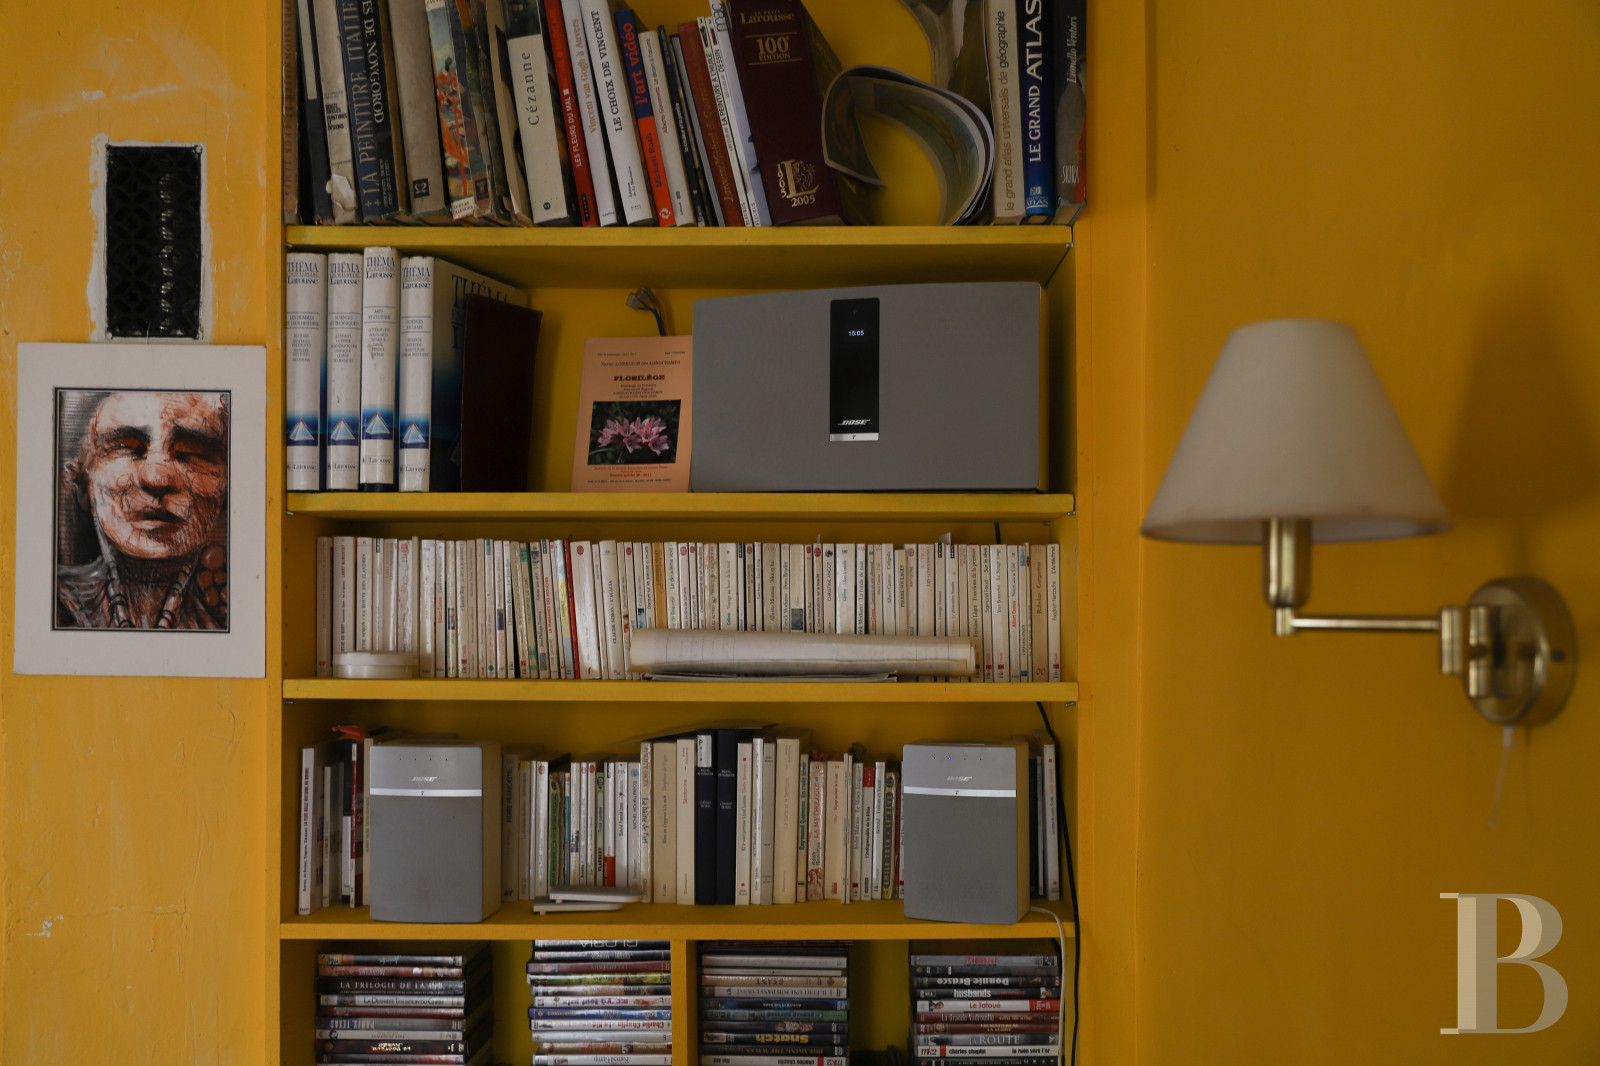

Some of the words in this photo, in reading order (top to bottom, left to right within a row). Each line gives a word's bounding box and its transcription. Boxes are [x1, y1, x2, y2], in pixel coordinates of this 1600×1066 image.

[740, 12, 796, 25] Larousse
[342, 0, 364, 62] ITALIE
[362, 17, 375, 38] DE
[590, 8, 608, 59] VINCENT
[1066, 15, 1077, 46] Venturi
[618, 21, 640, 68] vidéo
[994, 10, 1008, 70] géographie
[1024, 0, 1042, 81] ATLAS
[600, 60, 612, 76] DE
[713, 48, 724, 73] DESSIN
[1065, 46, 1078, 83] Lionello
[577, 58, 590, 81] Gogh
[364, 40, 386, 123] NOVGOROD
[997, 70, 1008, 86] de
[518, 51, 540, 126] Cézanne
[582, 81, 592, 98] van
[629, 69, 648, 105] l'art
[563, 95, 572, 112] MAL
[604, 78, 619, 115] CHOIX
[712, 83, 725, 117] PEINTURE
[356, 70, 376, 164] PEINTURE
[566, 112, 574, 124] DU
[584, 100, 598, 134] Vincent
[998, 87, 1010, 139] universalis
[1027, 84, 1041, 140] GRAND
[612, 116, 623, 132] LE
[720, 116, 728, 126] LA
[568, 124, 579, 152] FLEURS
[573, 152, 582, 167] LES
[1001, 141, 1012, 166] atlas
[1029, 142, 1041, 162] LE
[362, 170, 380, 196] LA
[1003, 167, 1015, 199] grand
[790, 194, 816, 208] 2005
[1004, 201, 1014, 211] le
[286, 260, 318, 273] THÉMA
[330, 260, 360, 274] THÉMA
[366, 254, 396, 268] THÉMA
[366, 271, 396, 280] Larousse
[402, 265, 430, 278] THÉMA
[288, 276, 319, 286] Larousse
[330, 277, 360, 286] Larousse
[402, 281, 430, 290] Larousse
[614, 373, 666, 382] FLORILÈGE
[837, 418, 870, 426] BOSE
[641, 796, 648, 805] La
[641, 823, 648, 831] de
[340, 981, 350, 989] LA
[354, 981, 396, 989] TRILOGIE
[936, 977, 971, 986] Brasco
[973, 977, 1010, 986] Donnie
[953, 988, 992, 999] husbands
[978, 1035, 1020, 1045] ROUTE
